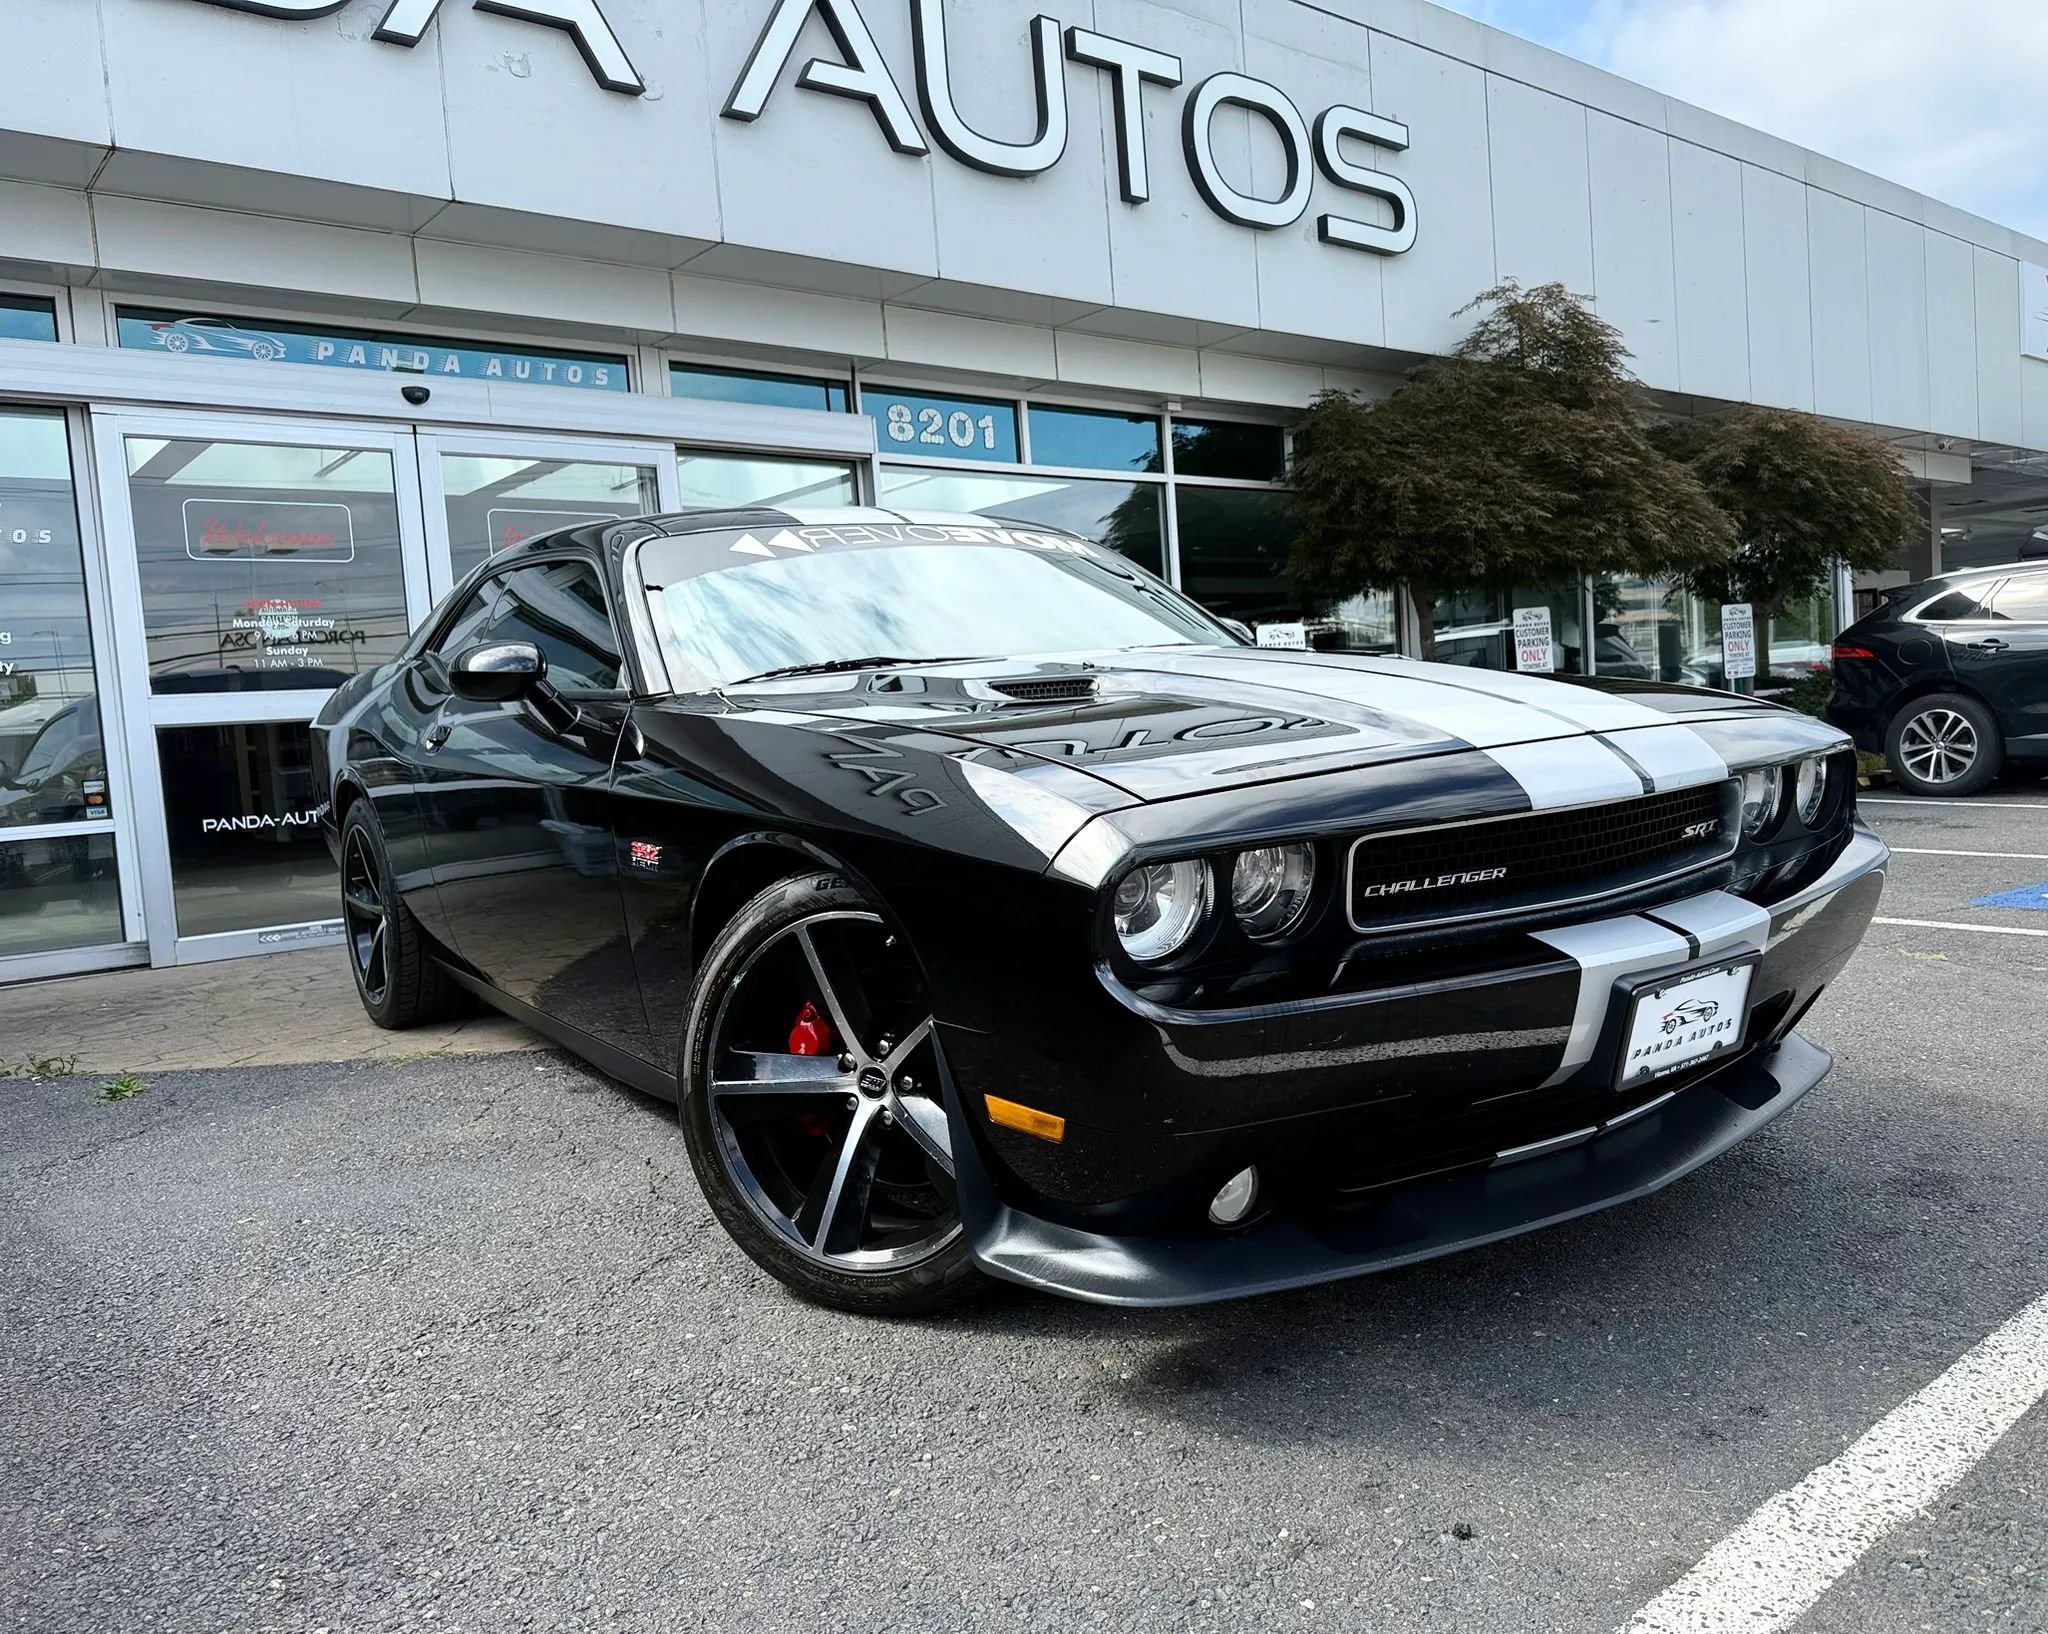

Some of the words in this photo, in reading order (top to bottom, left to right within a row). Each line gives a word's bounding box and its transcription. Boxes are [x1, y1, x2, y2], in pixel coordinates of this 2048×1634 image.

[720, 0, 1418, 256] AUTOS
[314, 340, 461, 373] PANDA
[486, 358, 609, 385] AUTOS
[887, 404, 995, 449] 8201
[8, 529, 51, 544] OS
[232, 615, 335, 629] Monday-Saturday
[1723, 621, 1752, 631] CUSTOMER
[254, 630, 261, 641] 9
[302, 630, 318, 640] PM
[1515, 627, 1549, 638] CUSTOMER
[1724, 630, 1752, 640] PARKING
[1518, 636, 1550, 649] PARKING
[1728, 640, 1749, 652] ONLY
[266, 645, 309, 657] Sunday
[1521, 648, 1547, 663] ONLY
[254, 659, 266, 669] 11
[270, 658, 288, 668] AM
[297, 658, 304, 668] 3
[307, 657, 324, 667] PM
[202, 811, 318, 832] PANDA-AUT
[1681, 819, 1719, 839] SRT
[1364, 867, 1507, 897] CHALLENGER
[1633, 1036, 1683, 1060] PANDA
[1688, 1018, 1733, 1042] AUTOS
